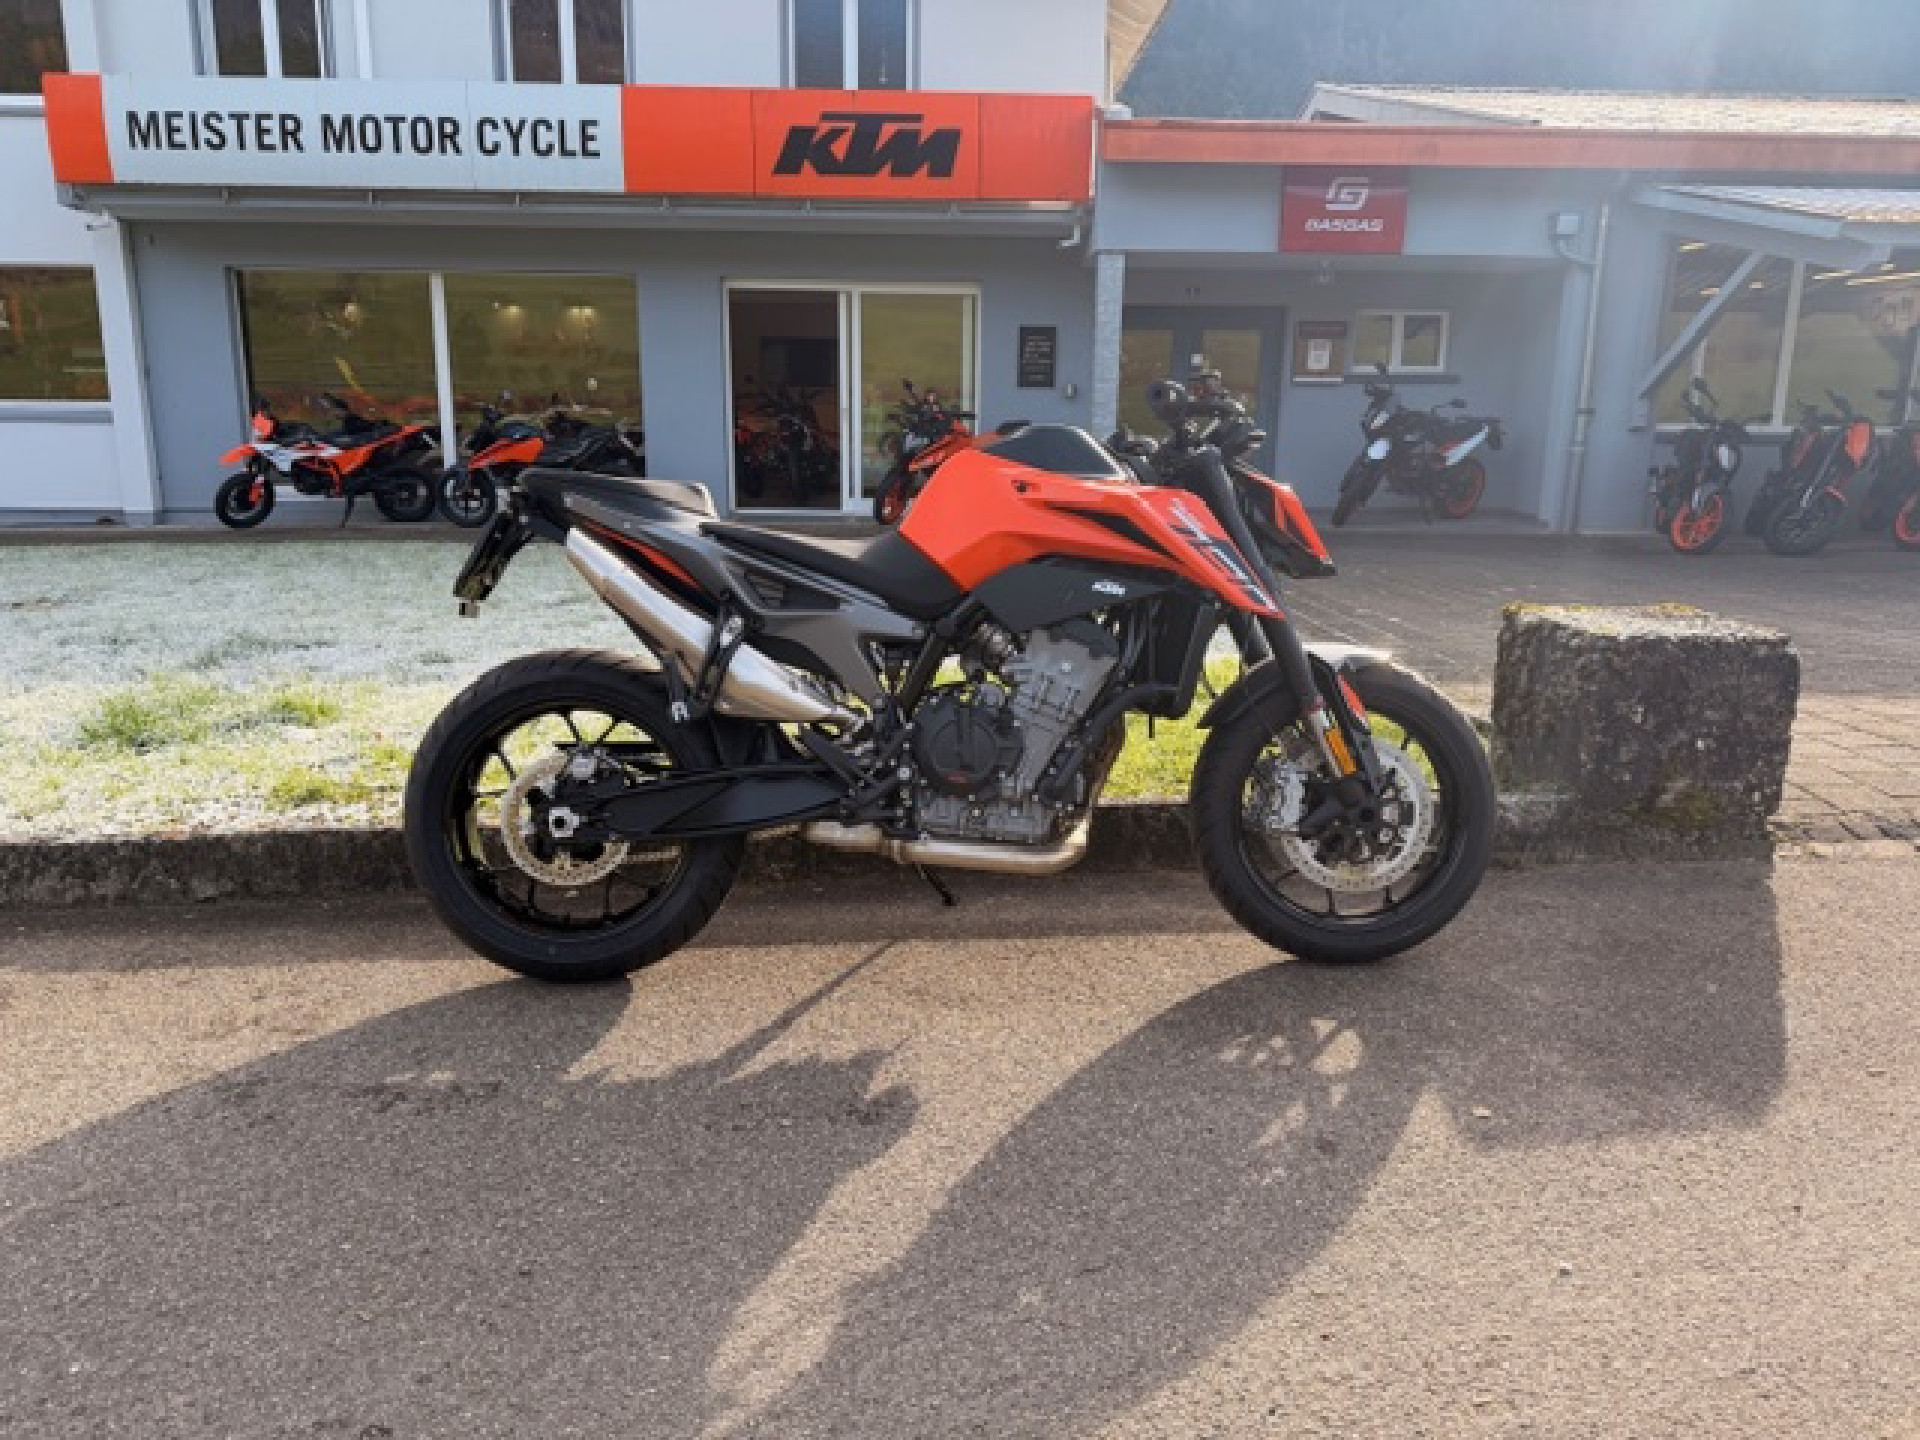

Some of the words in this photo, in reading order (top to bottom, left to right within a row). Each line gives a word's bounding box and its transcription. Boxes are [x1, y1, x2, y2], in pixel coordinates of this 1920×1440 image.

[126, 110, 306, 153] MEISTER
[321, 113, 463, 156] MOTOR
[476, 117, 600, 159] CYCLE
[772, 111, 963, 177] KTM
